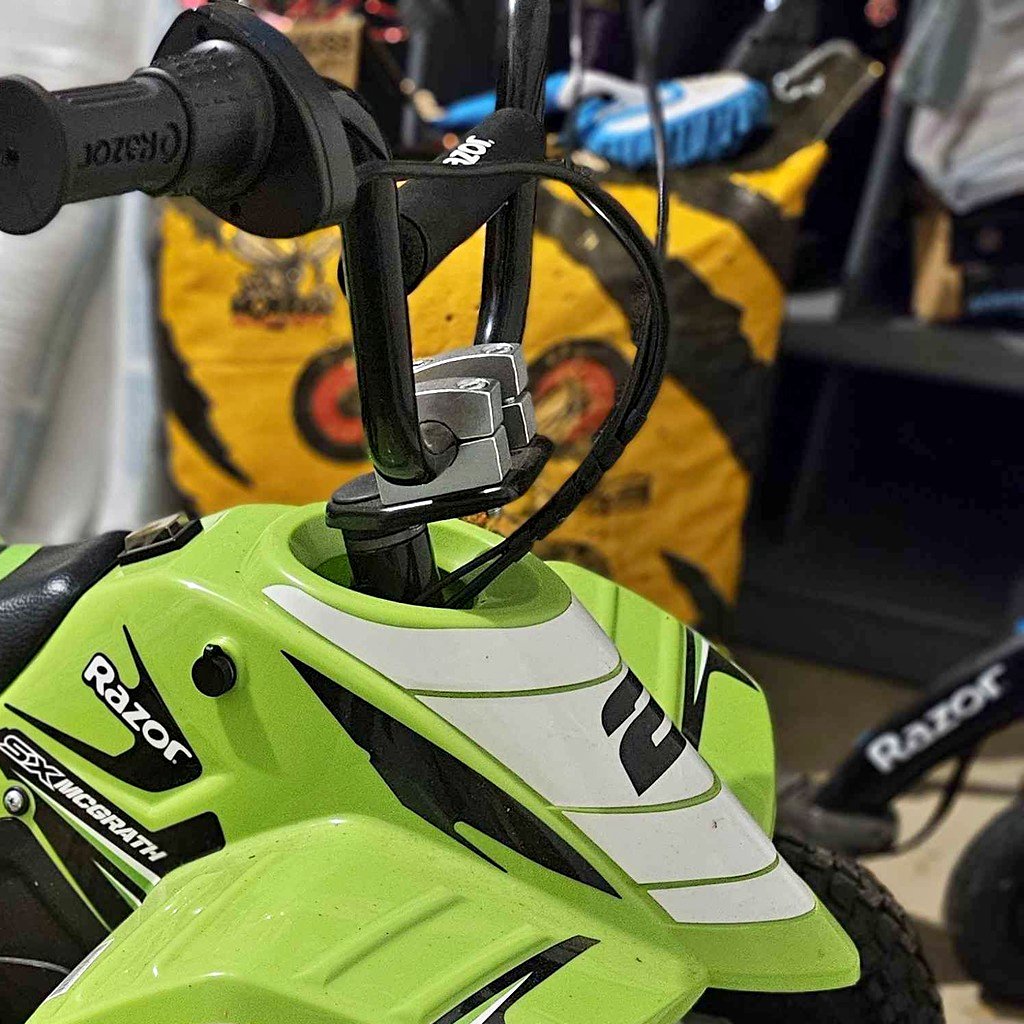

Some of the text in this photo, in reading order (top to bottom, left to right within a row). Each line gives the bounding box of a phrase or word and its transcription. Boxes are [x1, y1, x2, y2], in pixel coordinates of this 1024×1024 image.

[83, 655, 192, 764] Razor
[601, 667, 687, 796] 2
[866, 663, 1005, 773] Razor
